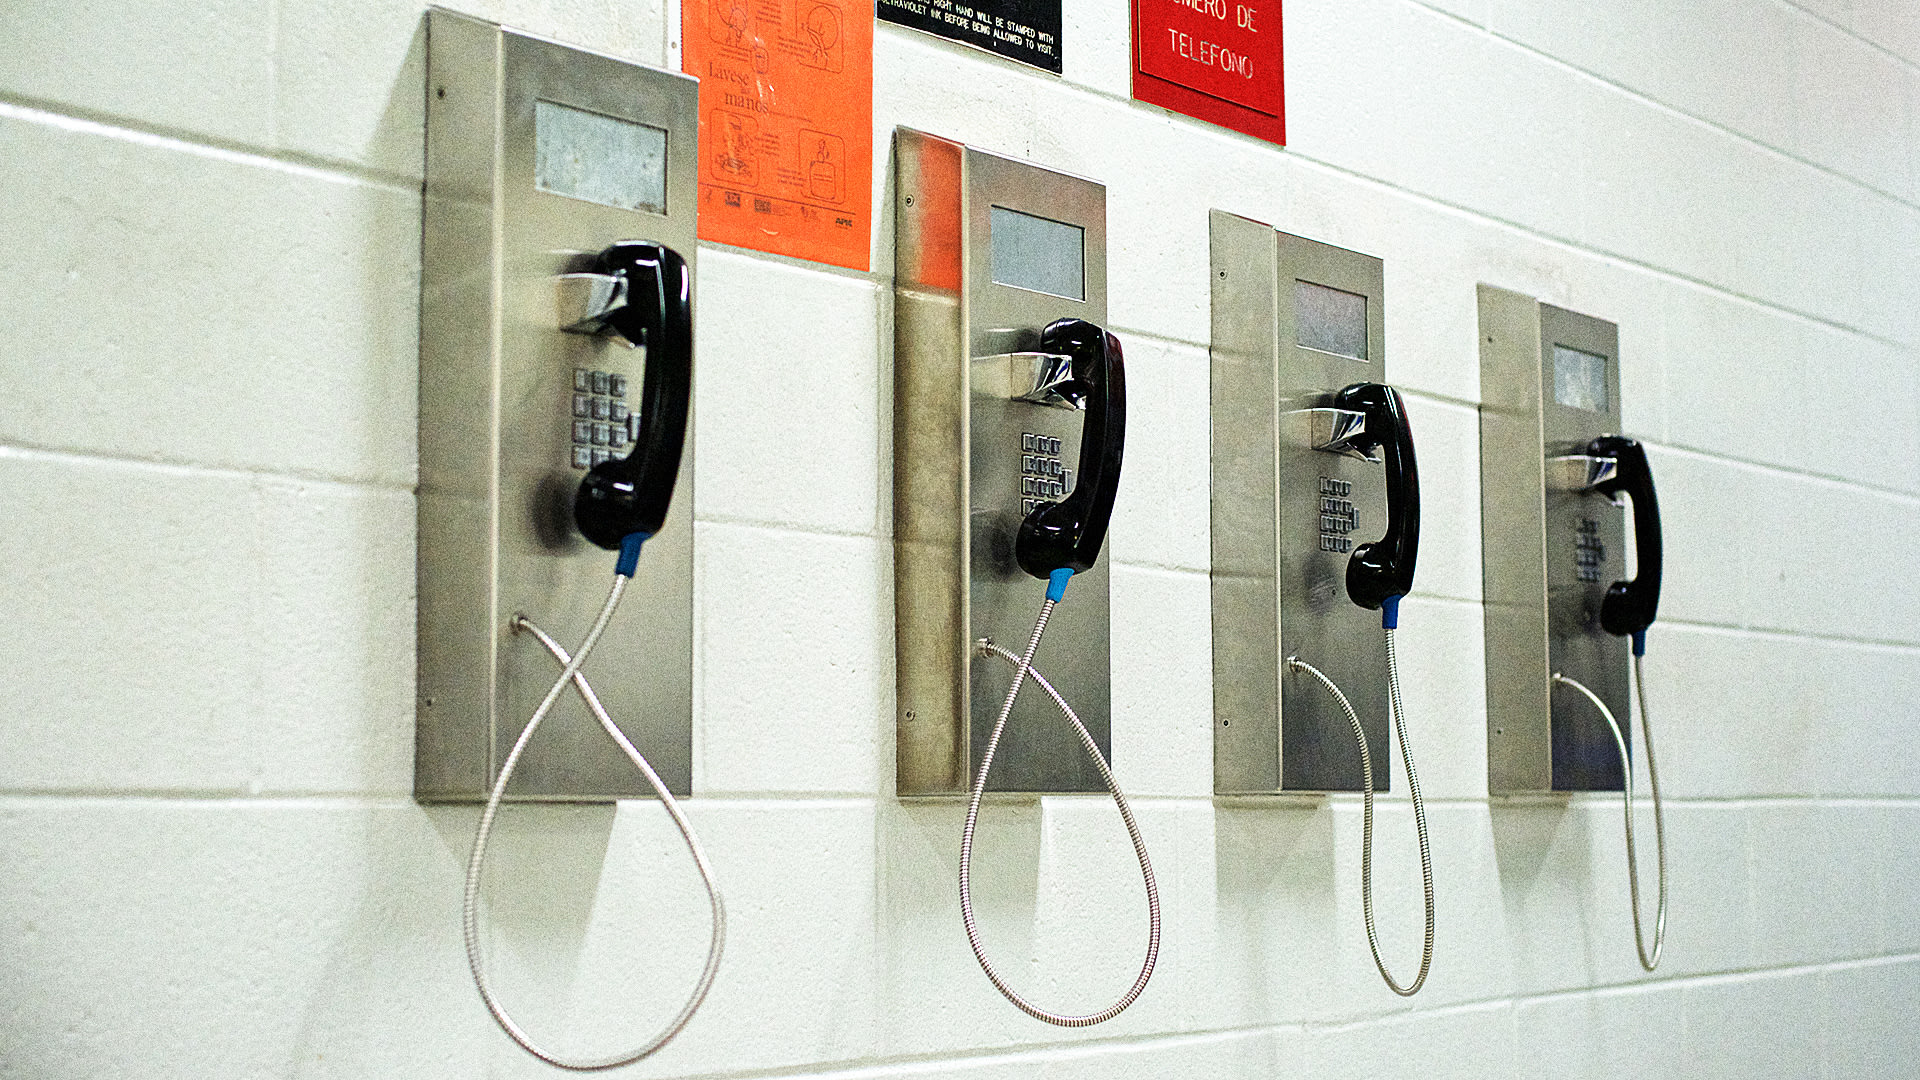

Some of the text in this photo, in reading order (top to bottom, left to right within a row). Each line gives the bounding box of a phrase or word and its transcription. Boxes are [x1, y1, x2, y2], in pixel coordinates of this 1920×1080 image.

[930, 8, 942, 20] INK
[944, 12, 970, 30] BEFORE
[972, 20, 991, 36] BEING
[993, 28, 1023, 46] ALLOWED
[1025, 38, 1035, 50] TO
[1037, 42, 1054, 57] VISIT.
[933, 0, 1054, 45] RIGHT HAND WILL BE STAMPED WITH
[1236, 4, 1258, 33] DE
[1167, 28, 1254, 79] TELEFONO
[724, 91, 769, 114] manos
